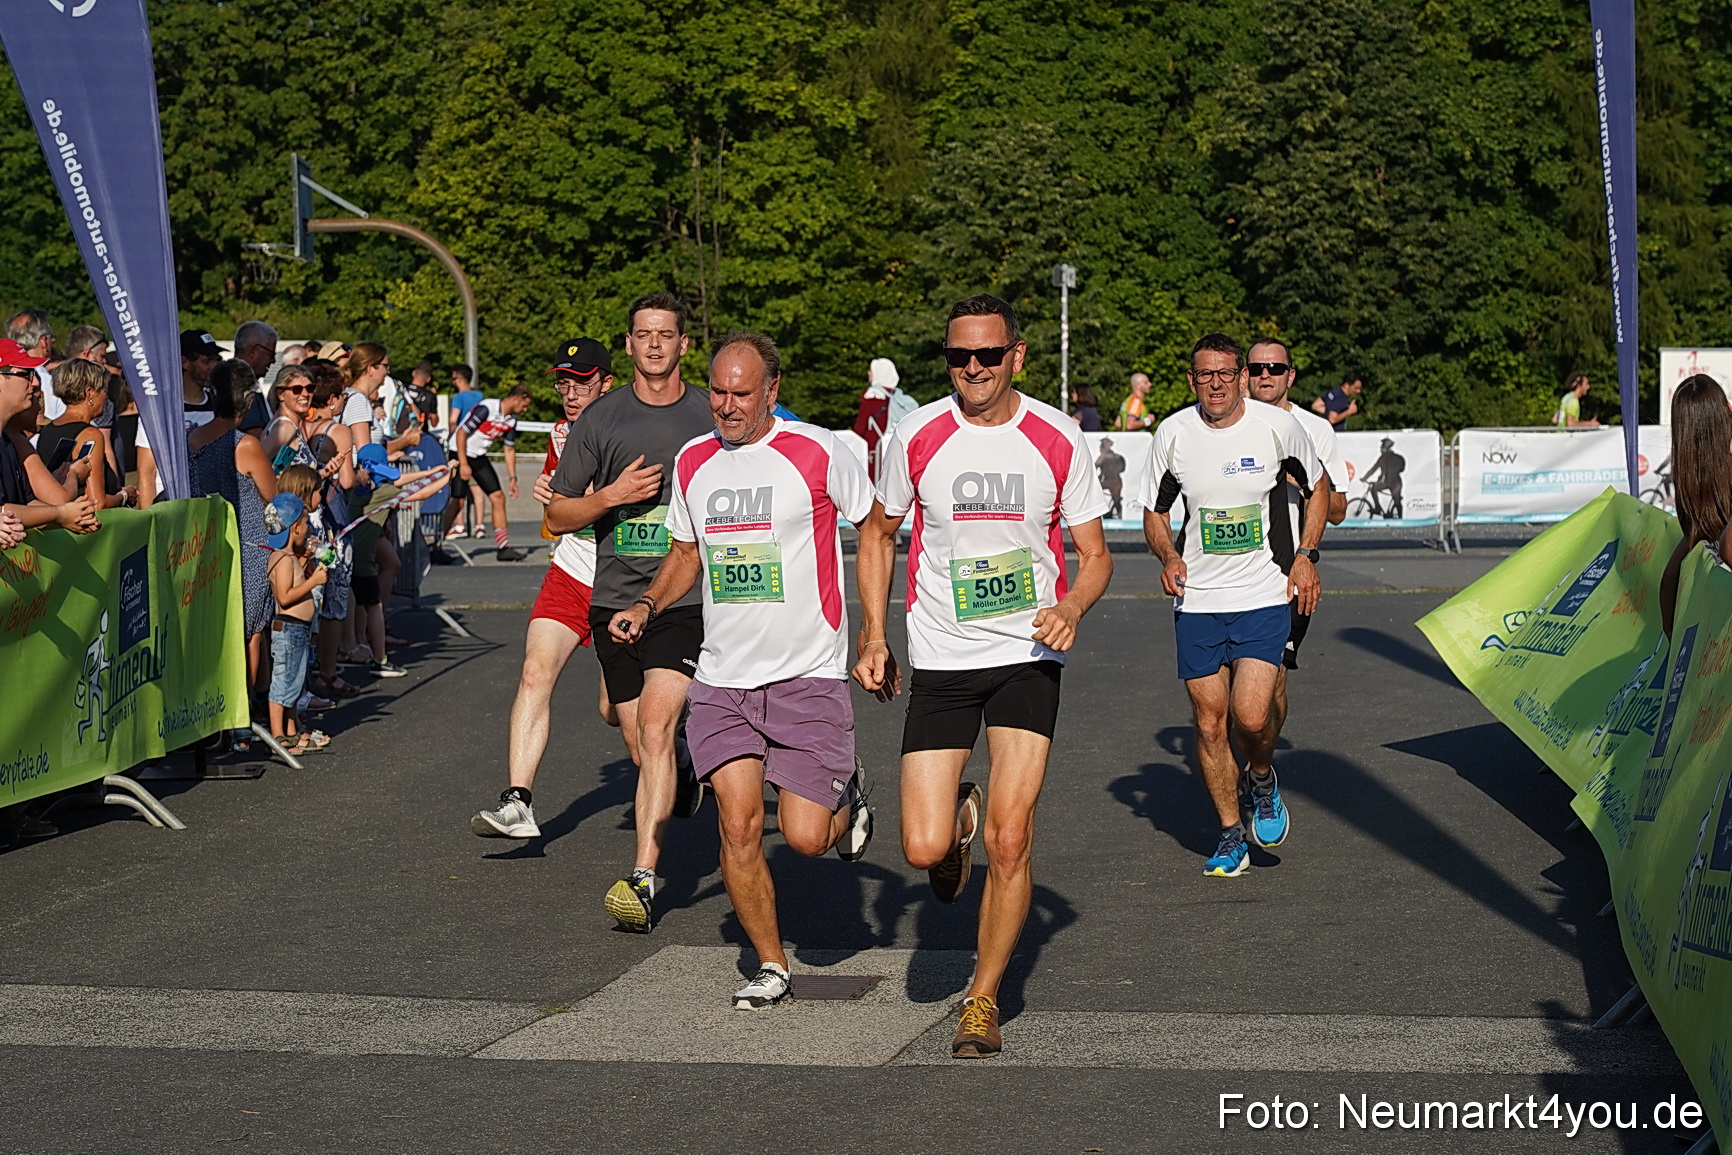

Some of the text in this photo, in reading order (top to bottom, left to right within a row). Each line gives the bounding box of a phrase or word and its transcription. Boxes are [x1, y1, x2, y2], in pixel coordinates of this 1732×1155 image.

[1482, 452, 1517, 464] NOW
[952, 471, 1025, 504] OM
[1484, 469, 1628, 486] E-BIKES & FAHRRÄDER
[706, 486, 773, 517] OM
[627, 523, 660, 540] 767
[1215, 522, 1247, 539] 530
[1232, 537, 1251, 545] Daniel
[1253, 521, 1261, 543] 2022
[712, 571, 721, 592] RUN
[725, 563, 763, 584] 503
[770, 565, 780, 593] 2022
[724, 584, 766, 593] Hampel Dirk
[975, 572, 1017, 599] 505
[1023, 571, 1034, 601] 2022
[957, 587, 968, 610] RUN
[972, 600, 998, 609] Möller
[999, 593, 1022, 605] Daniel
[682, 658, 699, 669] adida
